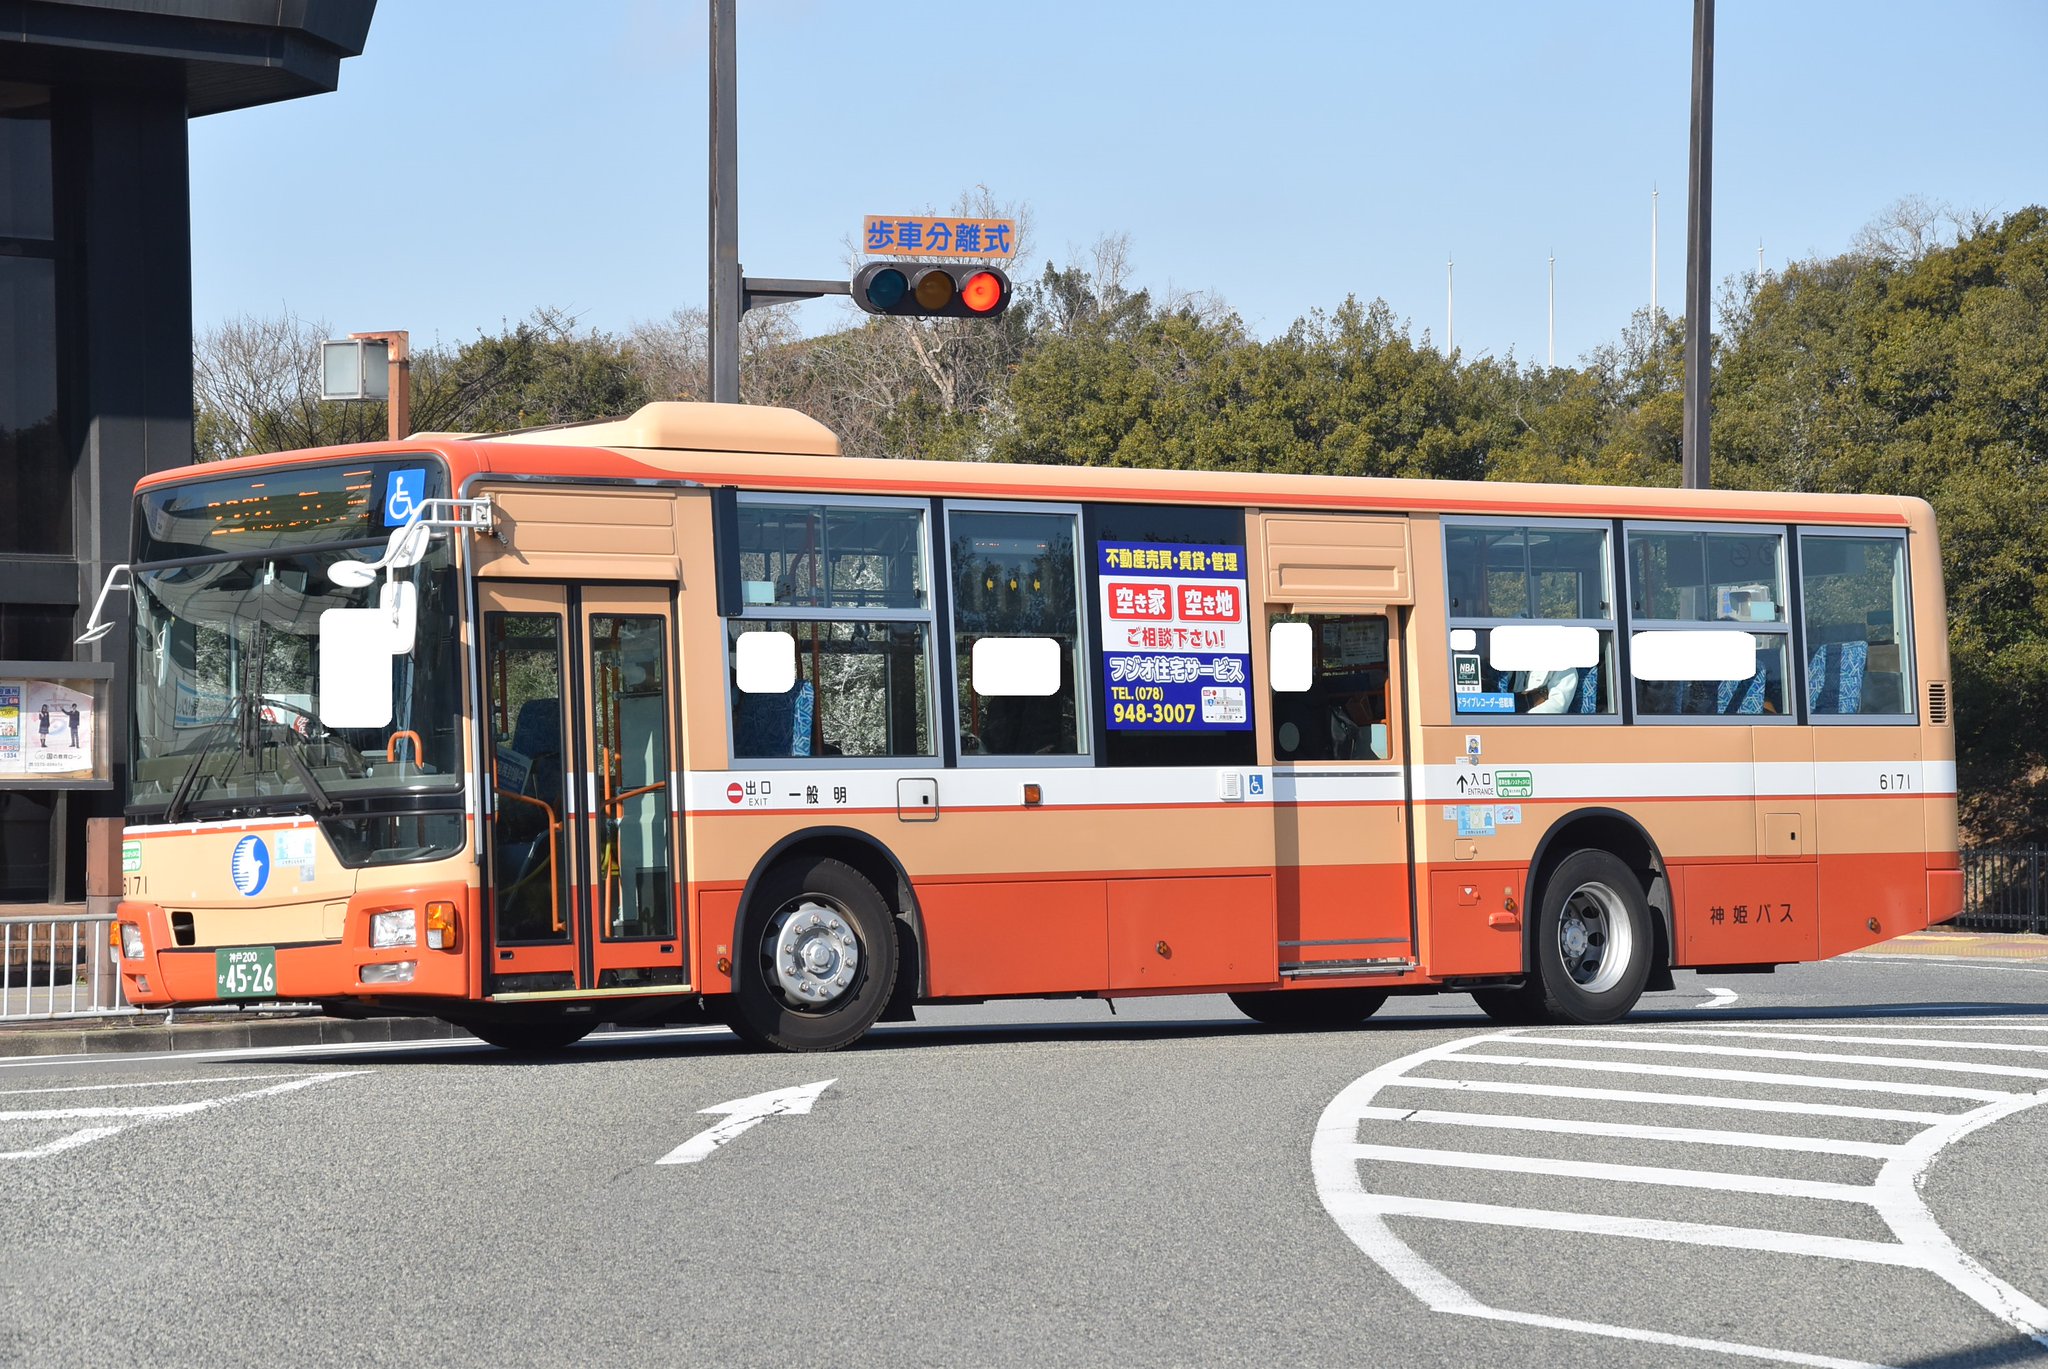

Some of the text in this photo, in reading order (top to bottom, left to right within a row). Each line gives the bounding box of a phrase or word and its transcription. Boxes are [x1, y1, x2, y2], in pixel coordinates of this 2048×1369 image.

[868, 220, 1010, 253] 歩車分離式
[1105, 548, 1238, 572] 不動産売買・賃貸・管理
[1115, 587, 1234, 617] 空き家 空き地
[1127, 627, 1226, 648] ご相談下さい!
[1110, 655, 1245, 683] フジオ住宅サービス
[1459, 663, 1476, 673] NBA
[1113, 703, 1196, 723] 948-3007
[745, 780, 771, 795] 出口
[1470, 773, 1491, 786] 入口
[1880, 774, 1910, 790] 6171
[789, 785, 847, 804] 一般 明
[1467, 787, 1494, 796] ENTRANCE
[748, 798, 768, 806] EXIT
[1710, 903, 1793, 925] 神姫バス
[218, 973, 225, 984] か
